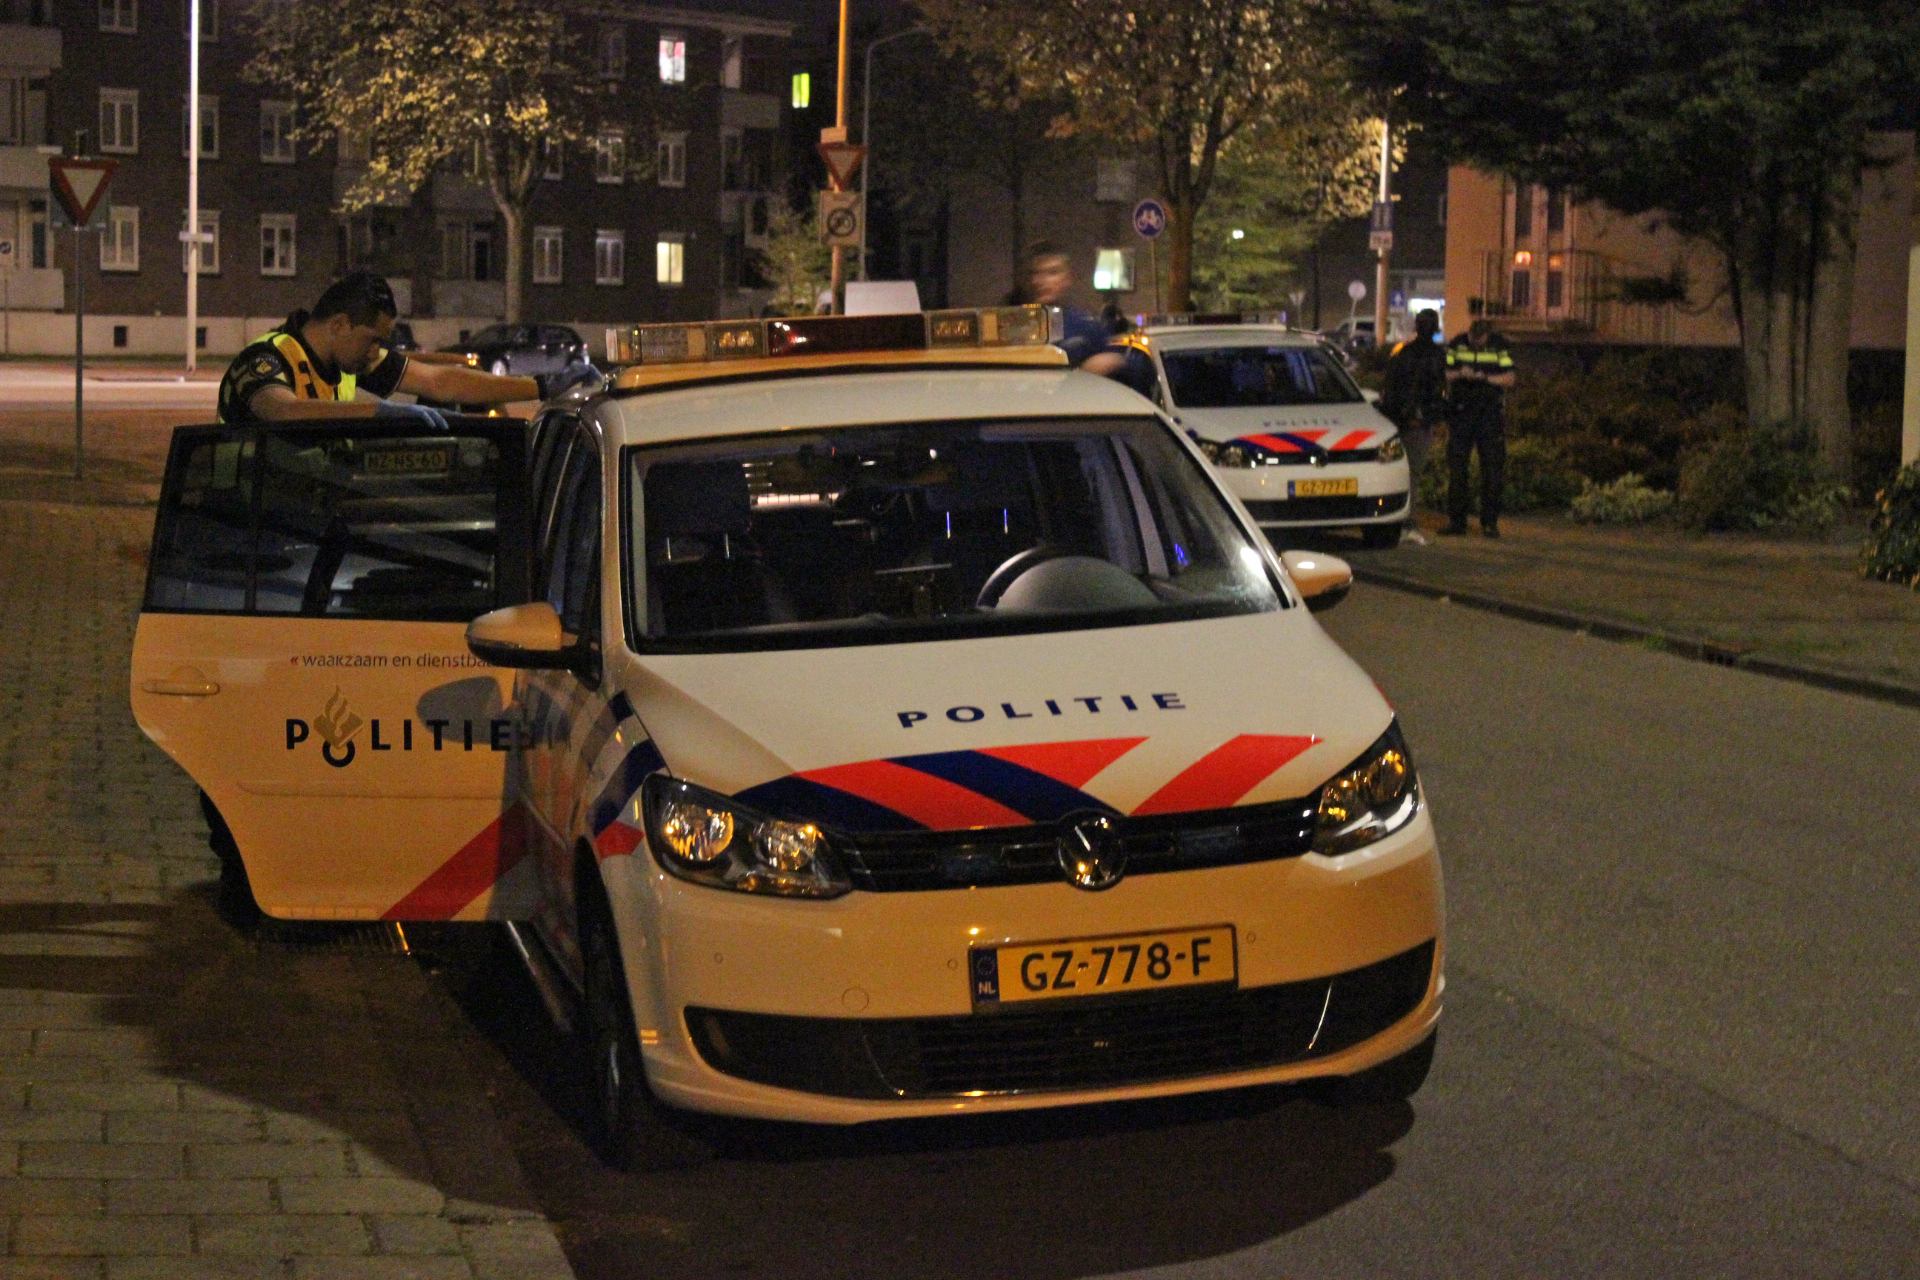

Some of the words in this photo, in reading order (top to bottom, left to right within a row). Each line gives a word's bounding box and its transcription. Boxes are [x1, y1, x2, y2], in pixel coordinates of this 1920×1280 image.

[303, 653, 387, 668] waakzaam
[392, 656, 411, 667] en
[416, 652, 498, 668] dienstba
[896, 692, 1186, 728] POLITIE
[285, 718, 512, 768] POLITIE
[1020, 937, 1212, 992] GZ-778-F
[978, 981, 996, 995] NL
